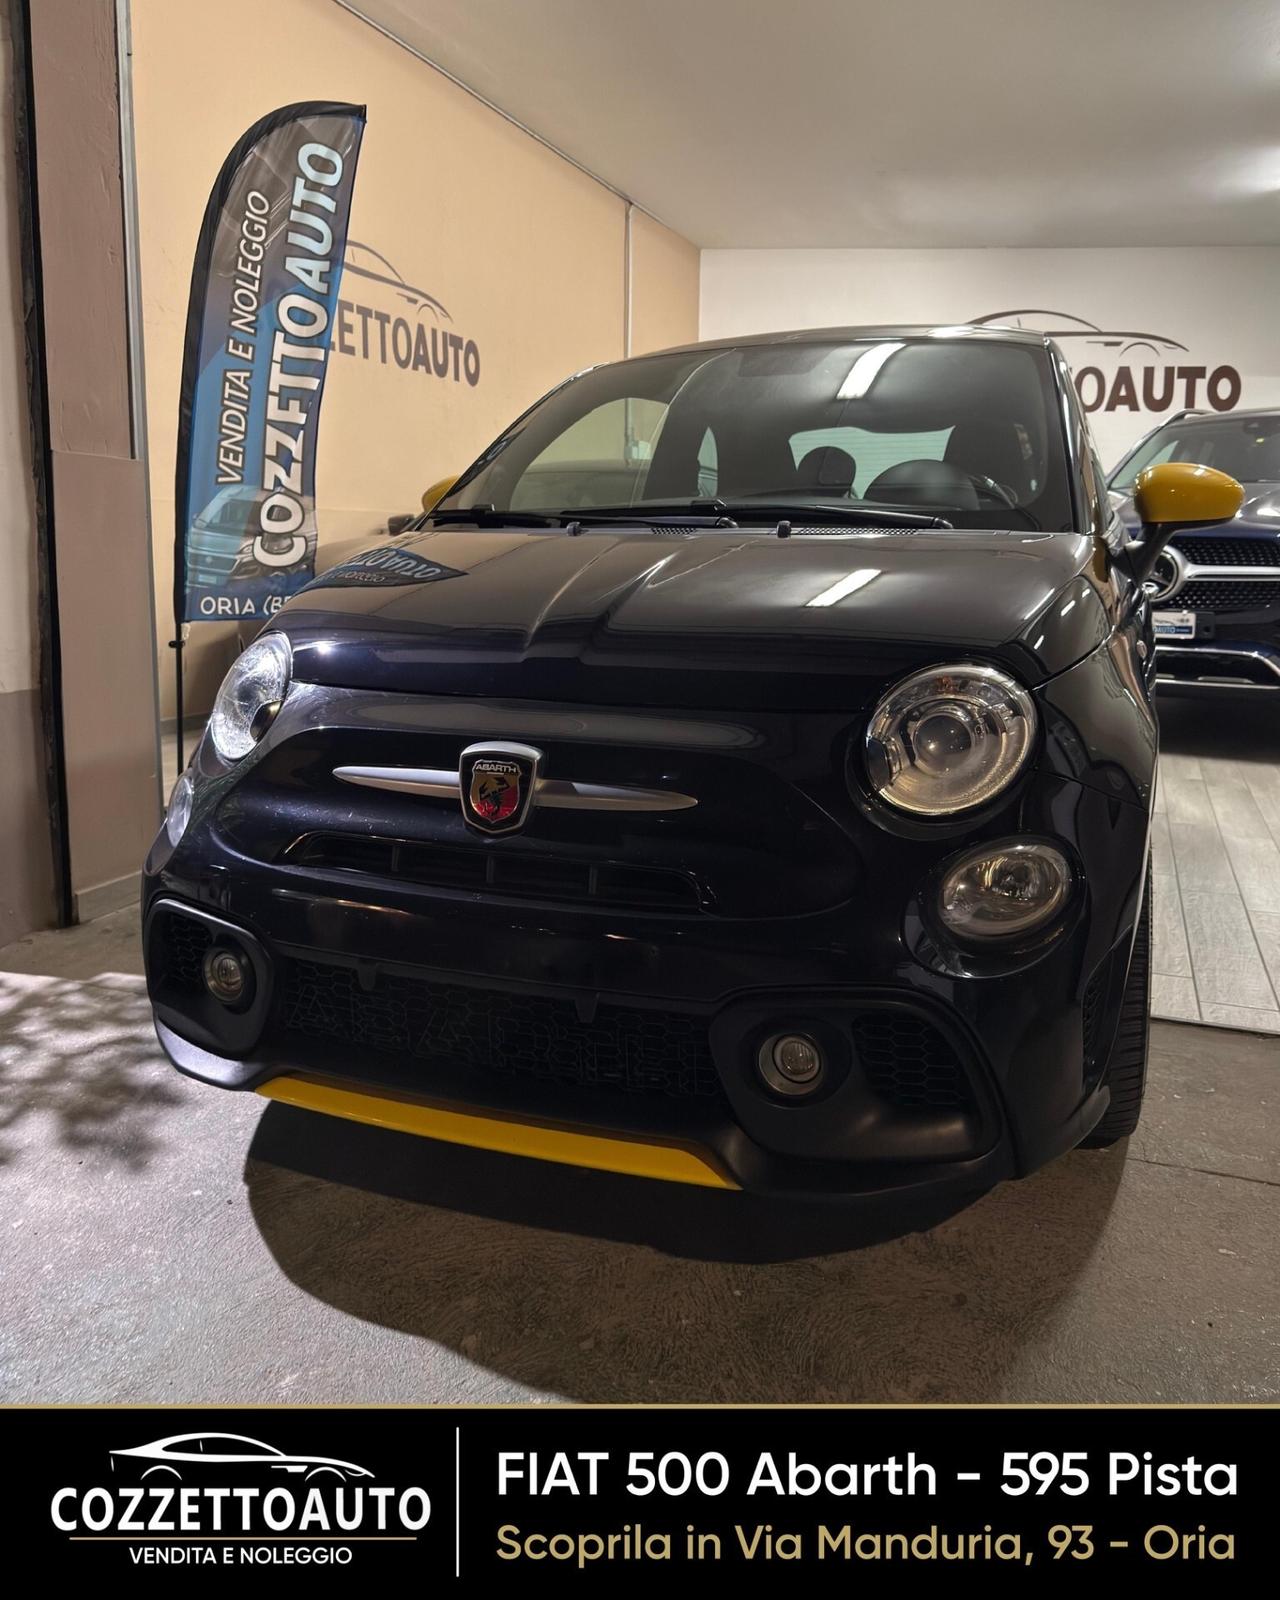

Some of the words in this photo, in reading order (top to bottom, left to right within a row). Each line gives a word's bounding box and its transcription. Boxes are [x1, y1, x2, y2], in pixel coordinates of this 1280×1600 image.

[230, 191, 270, 334] NOLEGGIO
[229, 340, 253, 360] E
[252, 142, 343, 567] COZZETTOAUTO
[331, 299, 481, 388] ETTOAUTO
[1069, 364, 1242, 413] OAUTO
[217, 371, 251, 484] VENDITA
[200, 596, 255, 615] ORIA
[475, 763, 517, 773] ABARTH
